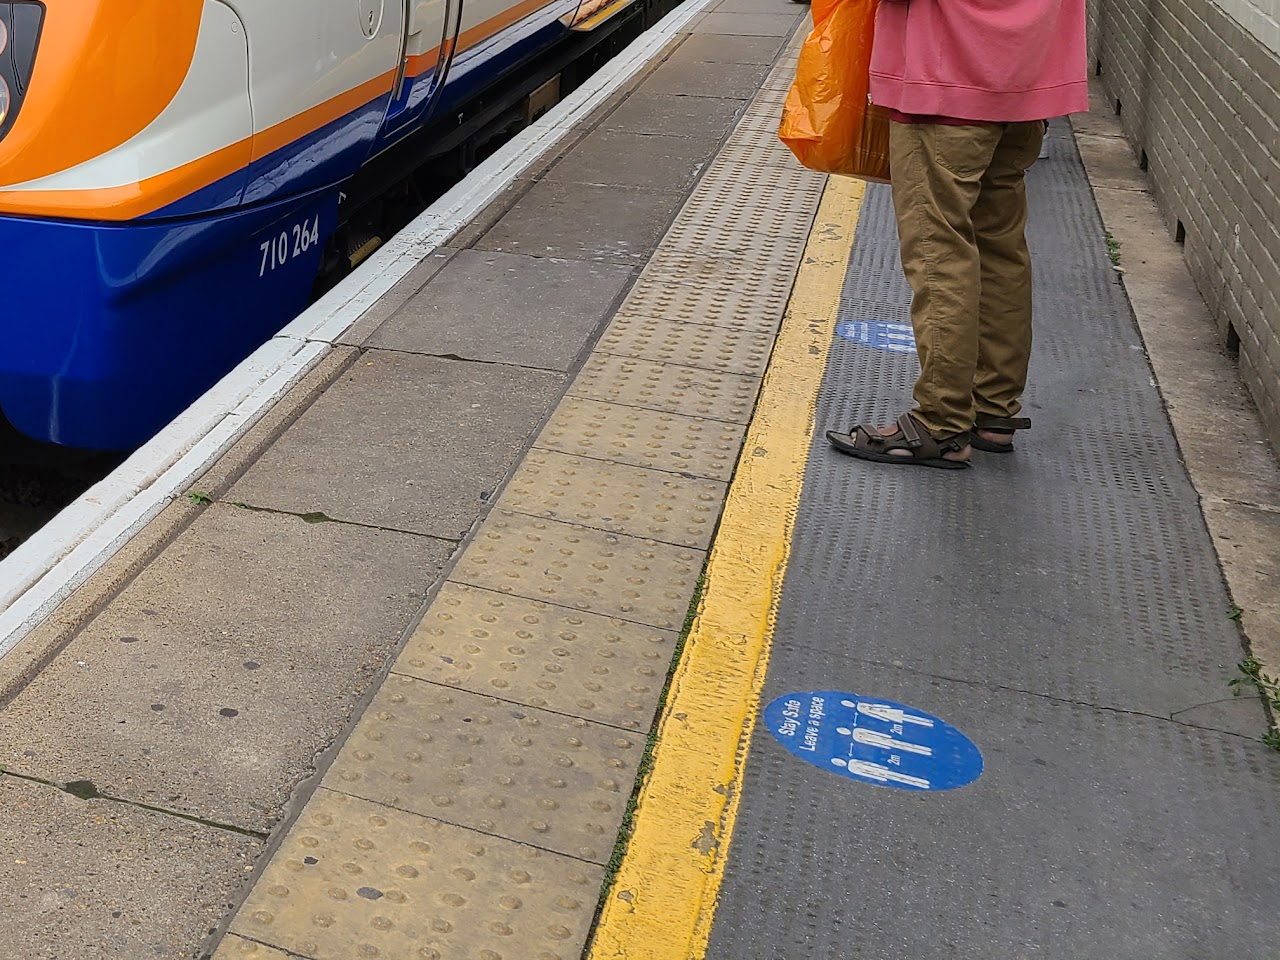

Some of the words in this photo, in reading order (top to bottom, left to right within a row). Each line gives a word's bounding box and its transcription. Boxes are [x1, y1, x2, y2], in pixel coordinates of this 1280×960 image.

[259, 231, 288, 277] 710
[292, 213, 319, 258] 264
[782, 699, 801, 718] Safe
[809, 696, 825, 720] space
[778, 717, 801, 736] Stay
[807, 719, 820, 727] a
[889, 723, 903, 735] 2m
[799, 727, 820, 751] Leave
[886, 754, 900, 766] 2m
